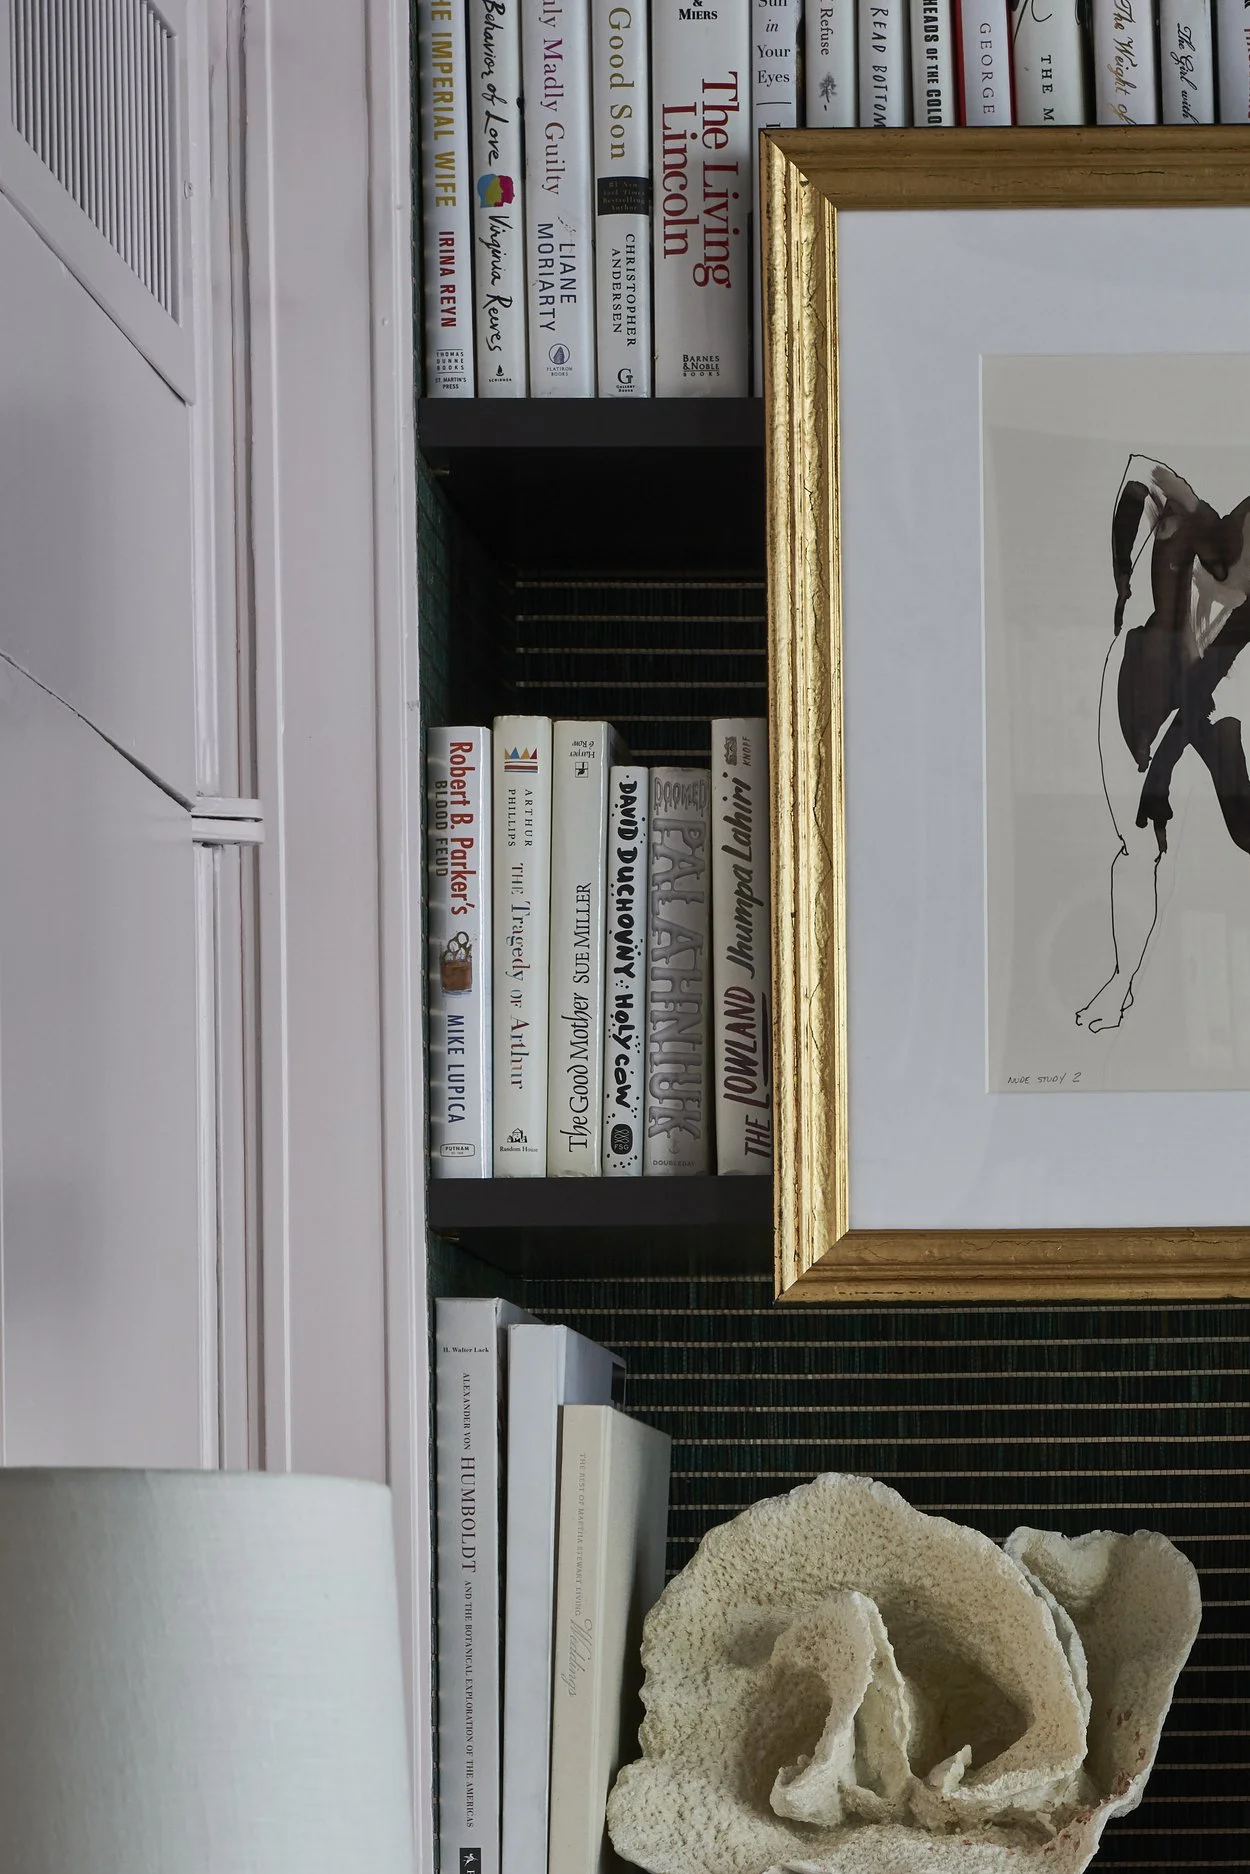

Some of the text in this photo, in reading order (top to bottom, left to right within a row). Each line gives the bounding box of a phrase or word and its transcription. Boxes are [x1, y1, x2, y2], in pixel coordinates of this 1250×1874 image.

[608, 7, 634, 90] Good
[757, 46, 791, 58] Your
[757, 71, 790, 85] Eyes
[980, 23, 994, 114] GEORGE
[431, 32, 456, 208] IMPERIAL WIFE
[483, 109, 509, 167] Love
[541, 38, 565, 196] Madly Guilty
[609, 104, 633, 159] Son
[662, 103, 699, 259] Lincoln
[693, 161, 739, 289] Living
[438, 231, 457, 328] IRINA REYN
[479, 215, 513, 352] Virginia Reeves
[537, 223, 556, 331] MORIARTY
[559, 243, 577, 304] LIANE
[612, 248, 622, 334] ANDERSEN
[626, 233, 637, 346] CHRISTOPHER
[434, 780, 447, 877] BLOOD FEUD
[449, 742, 476, 916] Robert Parker's
[572, 882, 592, 947] MILLER
[447, 1015, 466, 1124] MIKE LUPICA
[561, 993, 593, 1113] Good Mother
[461, 1373, 476, 1572] ALEXANDER HUMBOLDT
